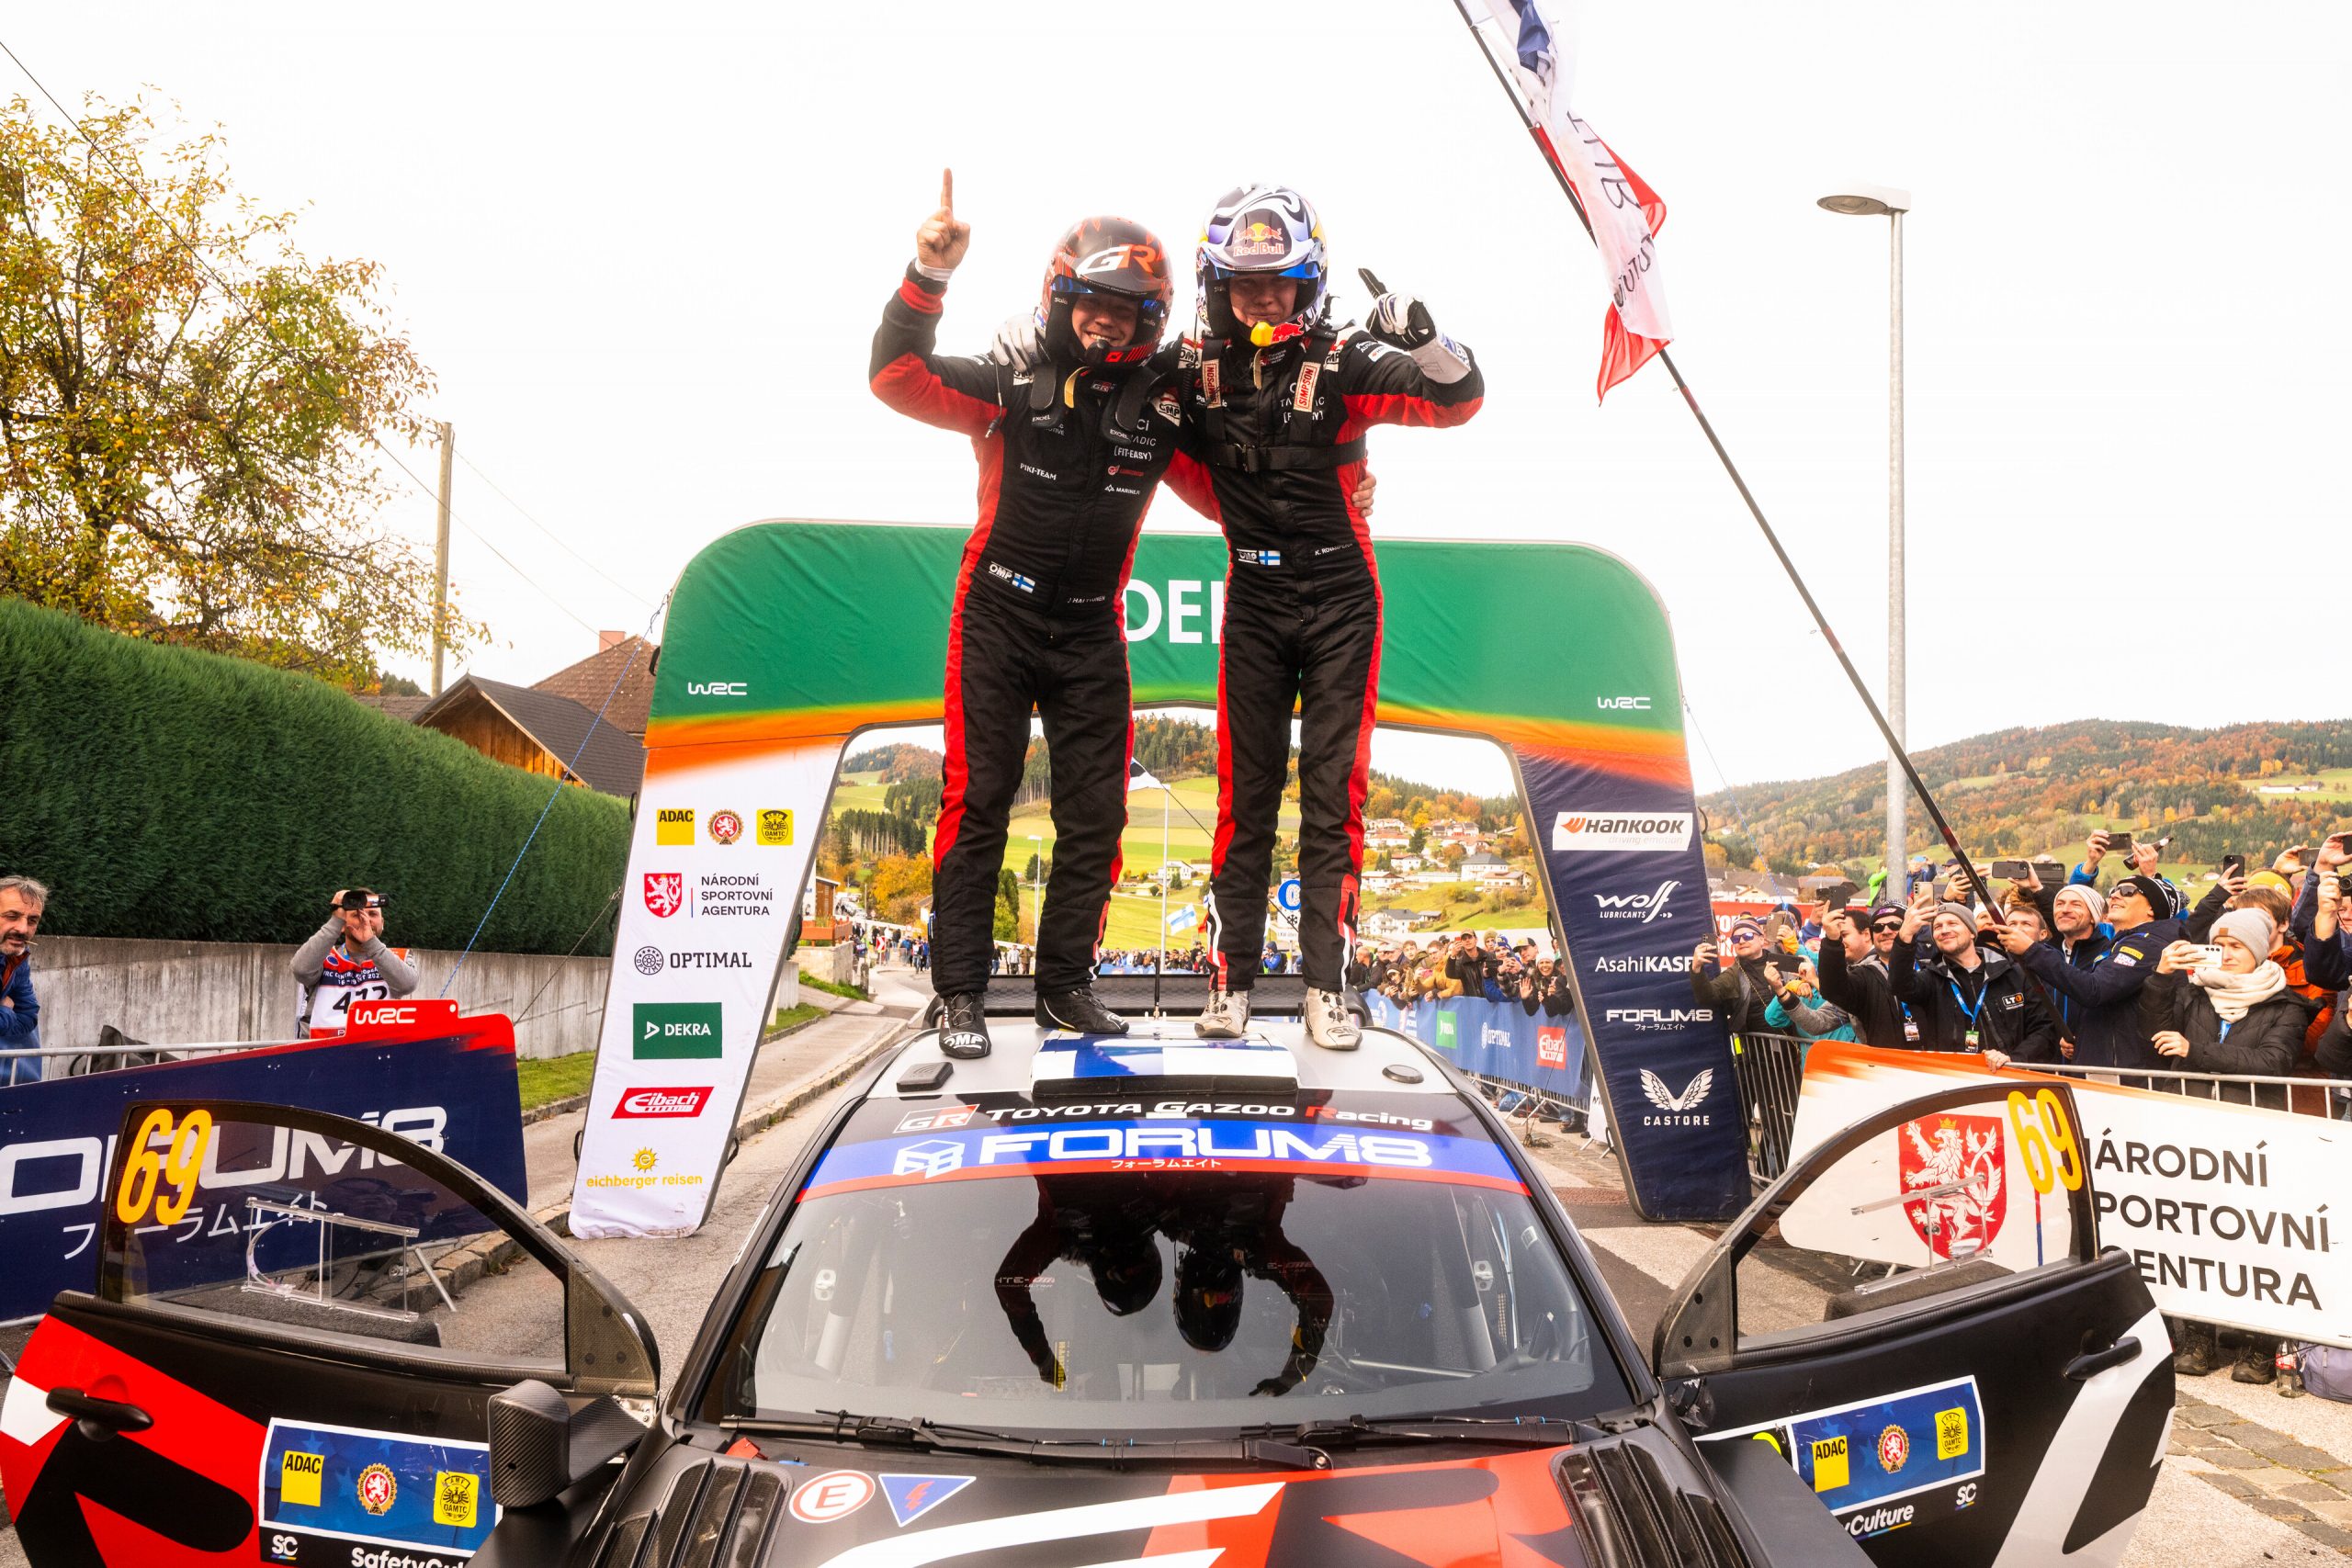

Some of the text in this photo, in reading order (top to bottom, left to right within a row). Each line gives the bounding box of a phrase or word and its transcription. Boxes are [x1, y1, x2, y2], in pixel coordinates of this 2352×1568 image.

[1233, 243, 1284, 256] Red Bull
[1077, 244, 1156, 278] GR
[1206, 367, 1217, 402] SMPSON
[1299, 368, 1314, 406] SIMPSON
[1020, 463, 1057, 480] PIKI-TEAM
[989, 563, 1012, 581] OMP
[688, 682, 748, 695] WRC
[1597, 696, 1651, 709] WRC
[659, 810, 694, 822] ADAC
[701, 874, 759, 886] NÁRODNÍ
[701, 888, 773, 900] SPORTOVNÍ
[701, 906, 770, 916] AGENTURA
[1600, 910, 1646, 919] LUBRICANTS
[670, 952, 752, 968] OPTIMAL
[1595, 956, 1693, 973] AsahiKAS
[355, 1008, 417, 1025] WRC
[1606, 1009, 1713, 1022] FORUM8
[664, 1023, 712, 1036] DEKRA
[624, 1092, 700, 1113] Eibach
[899, 1101, 1433, 1131] GR TOYOTA GAZOO Racing
[1644, 1115, 1710, 1126] CASTORE
[978, 1127, 1433, 1168] FORUM8
[2007, 1089, 2083, 1194] 69
[0, 1106, 447, 1215] ORUM8
[117, 1109, 212, 1225] 69
[1111, 1158, 1222, 1169] フォーラムエイト
[586, 1173, 703, 1189] eichberger reisen
[63, 1190, 327, 1260] フーラムエイト
[2095, 1190, 2330, 1253] PORTOVNÍ
[2100, 1246, 2323, 1310] ENTURA
[1815, 1438, 1846, 1461] ADAC
[285, 1454, 322, 1474] ADAC
[815, 1483, 852, 1509] E
[1956, 1483, 1977, 1506] SC
[271, 1534, 299, 1556] SC
